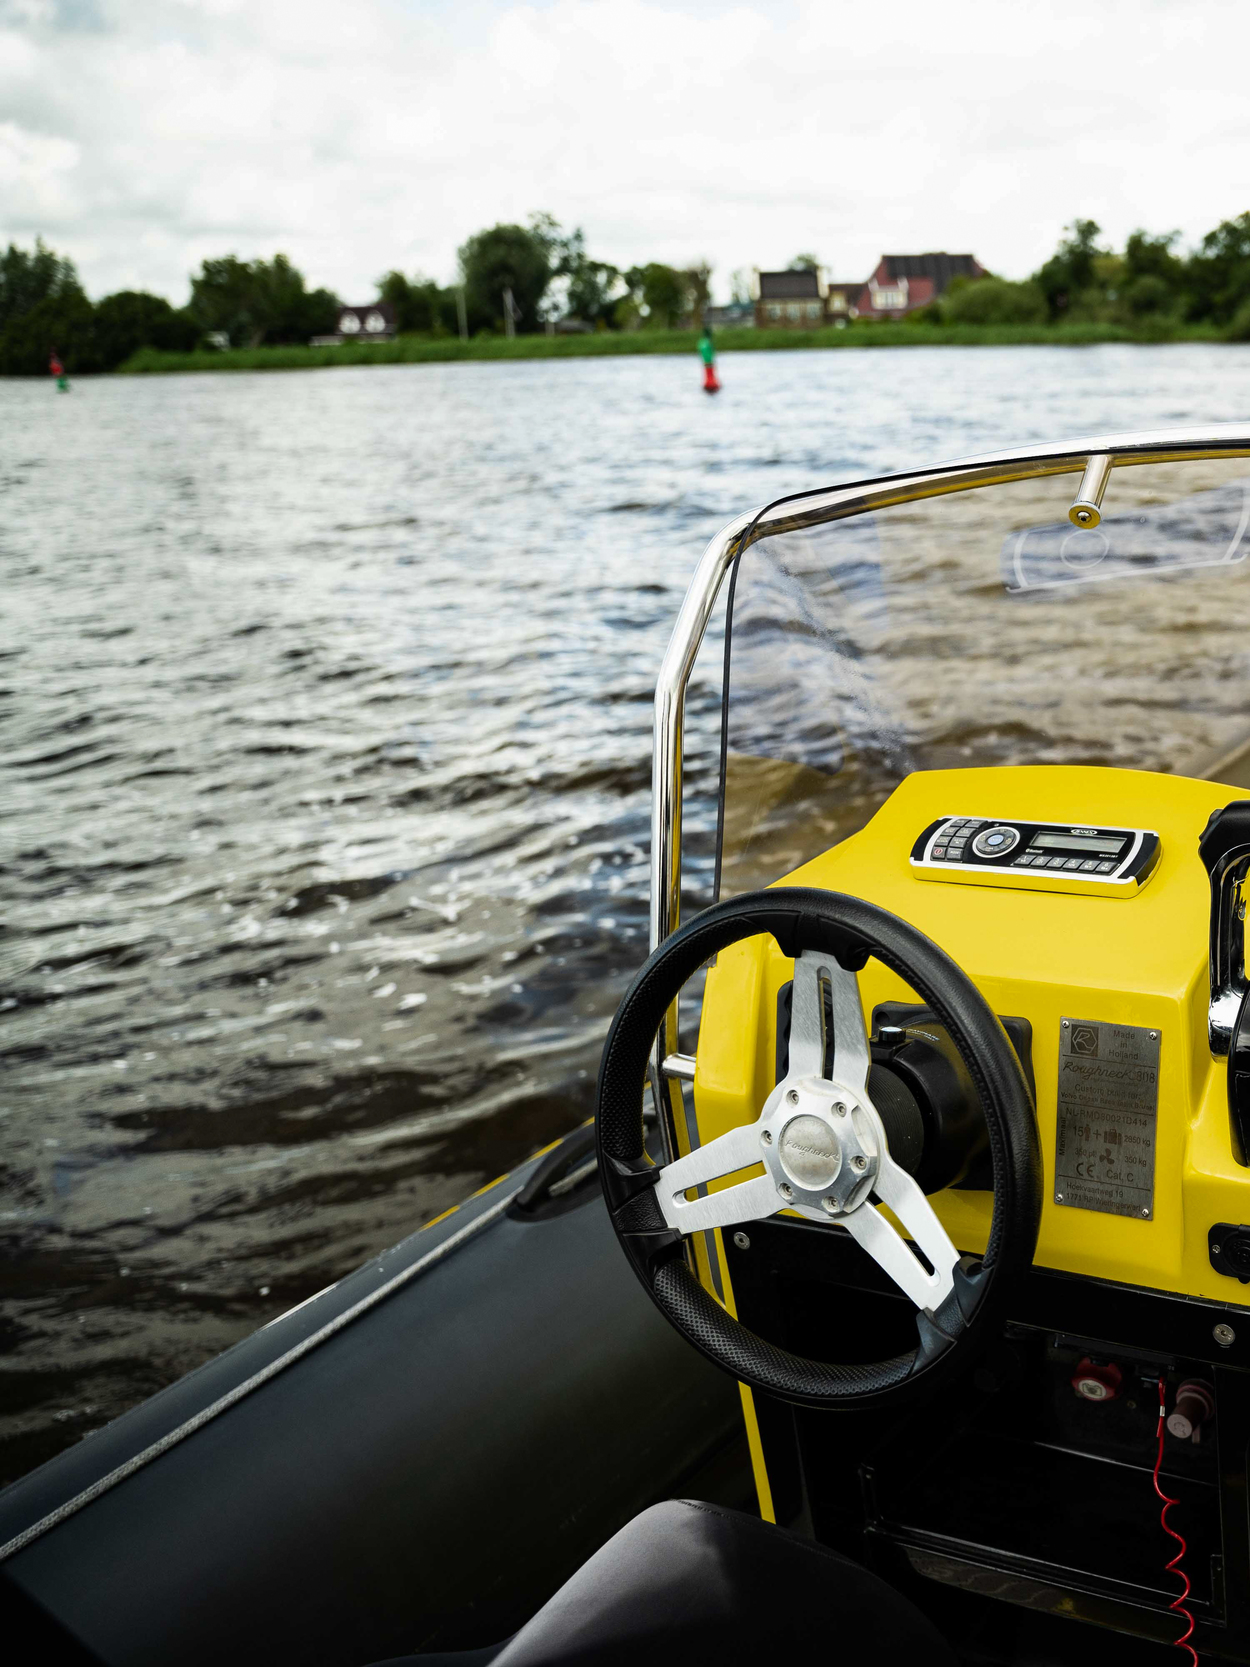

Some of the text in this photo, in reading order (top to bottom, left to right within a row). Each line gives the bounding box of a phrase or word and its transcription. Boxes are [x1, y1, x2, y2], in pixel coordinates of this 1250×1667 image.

[1113, 1030, 1136, 1040] Made
[1120, 1041, 1128, 1049] in
[1109, 1049, 1139, 1061] Holland
[1058, 1116, 1067, 1156] Maximaal
[1073, 1125, 1084, 1138] 15
[1142, 1138, 1151, 1148] kg
[1124, 1156, 1147, 1168] 350 kg
[1126, 1172, 1134, 1183] C
[1115, 1190, 1124, 1198] 19
